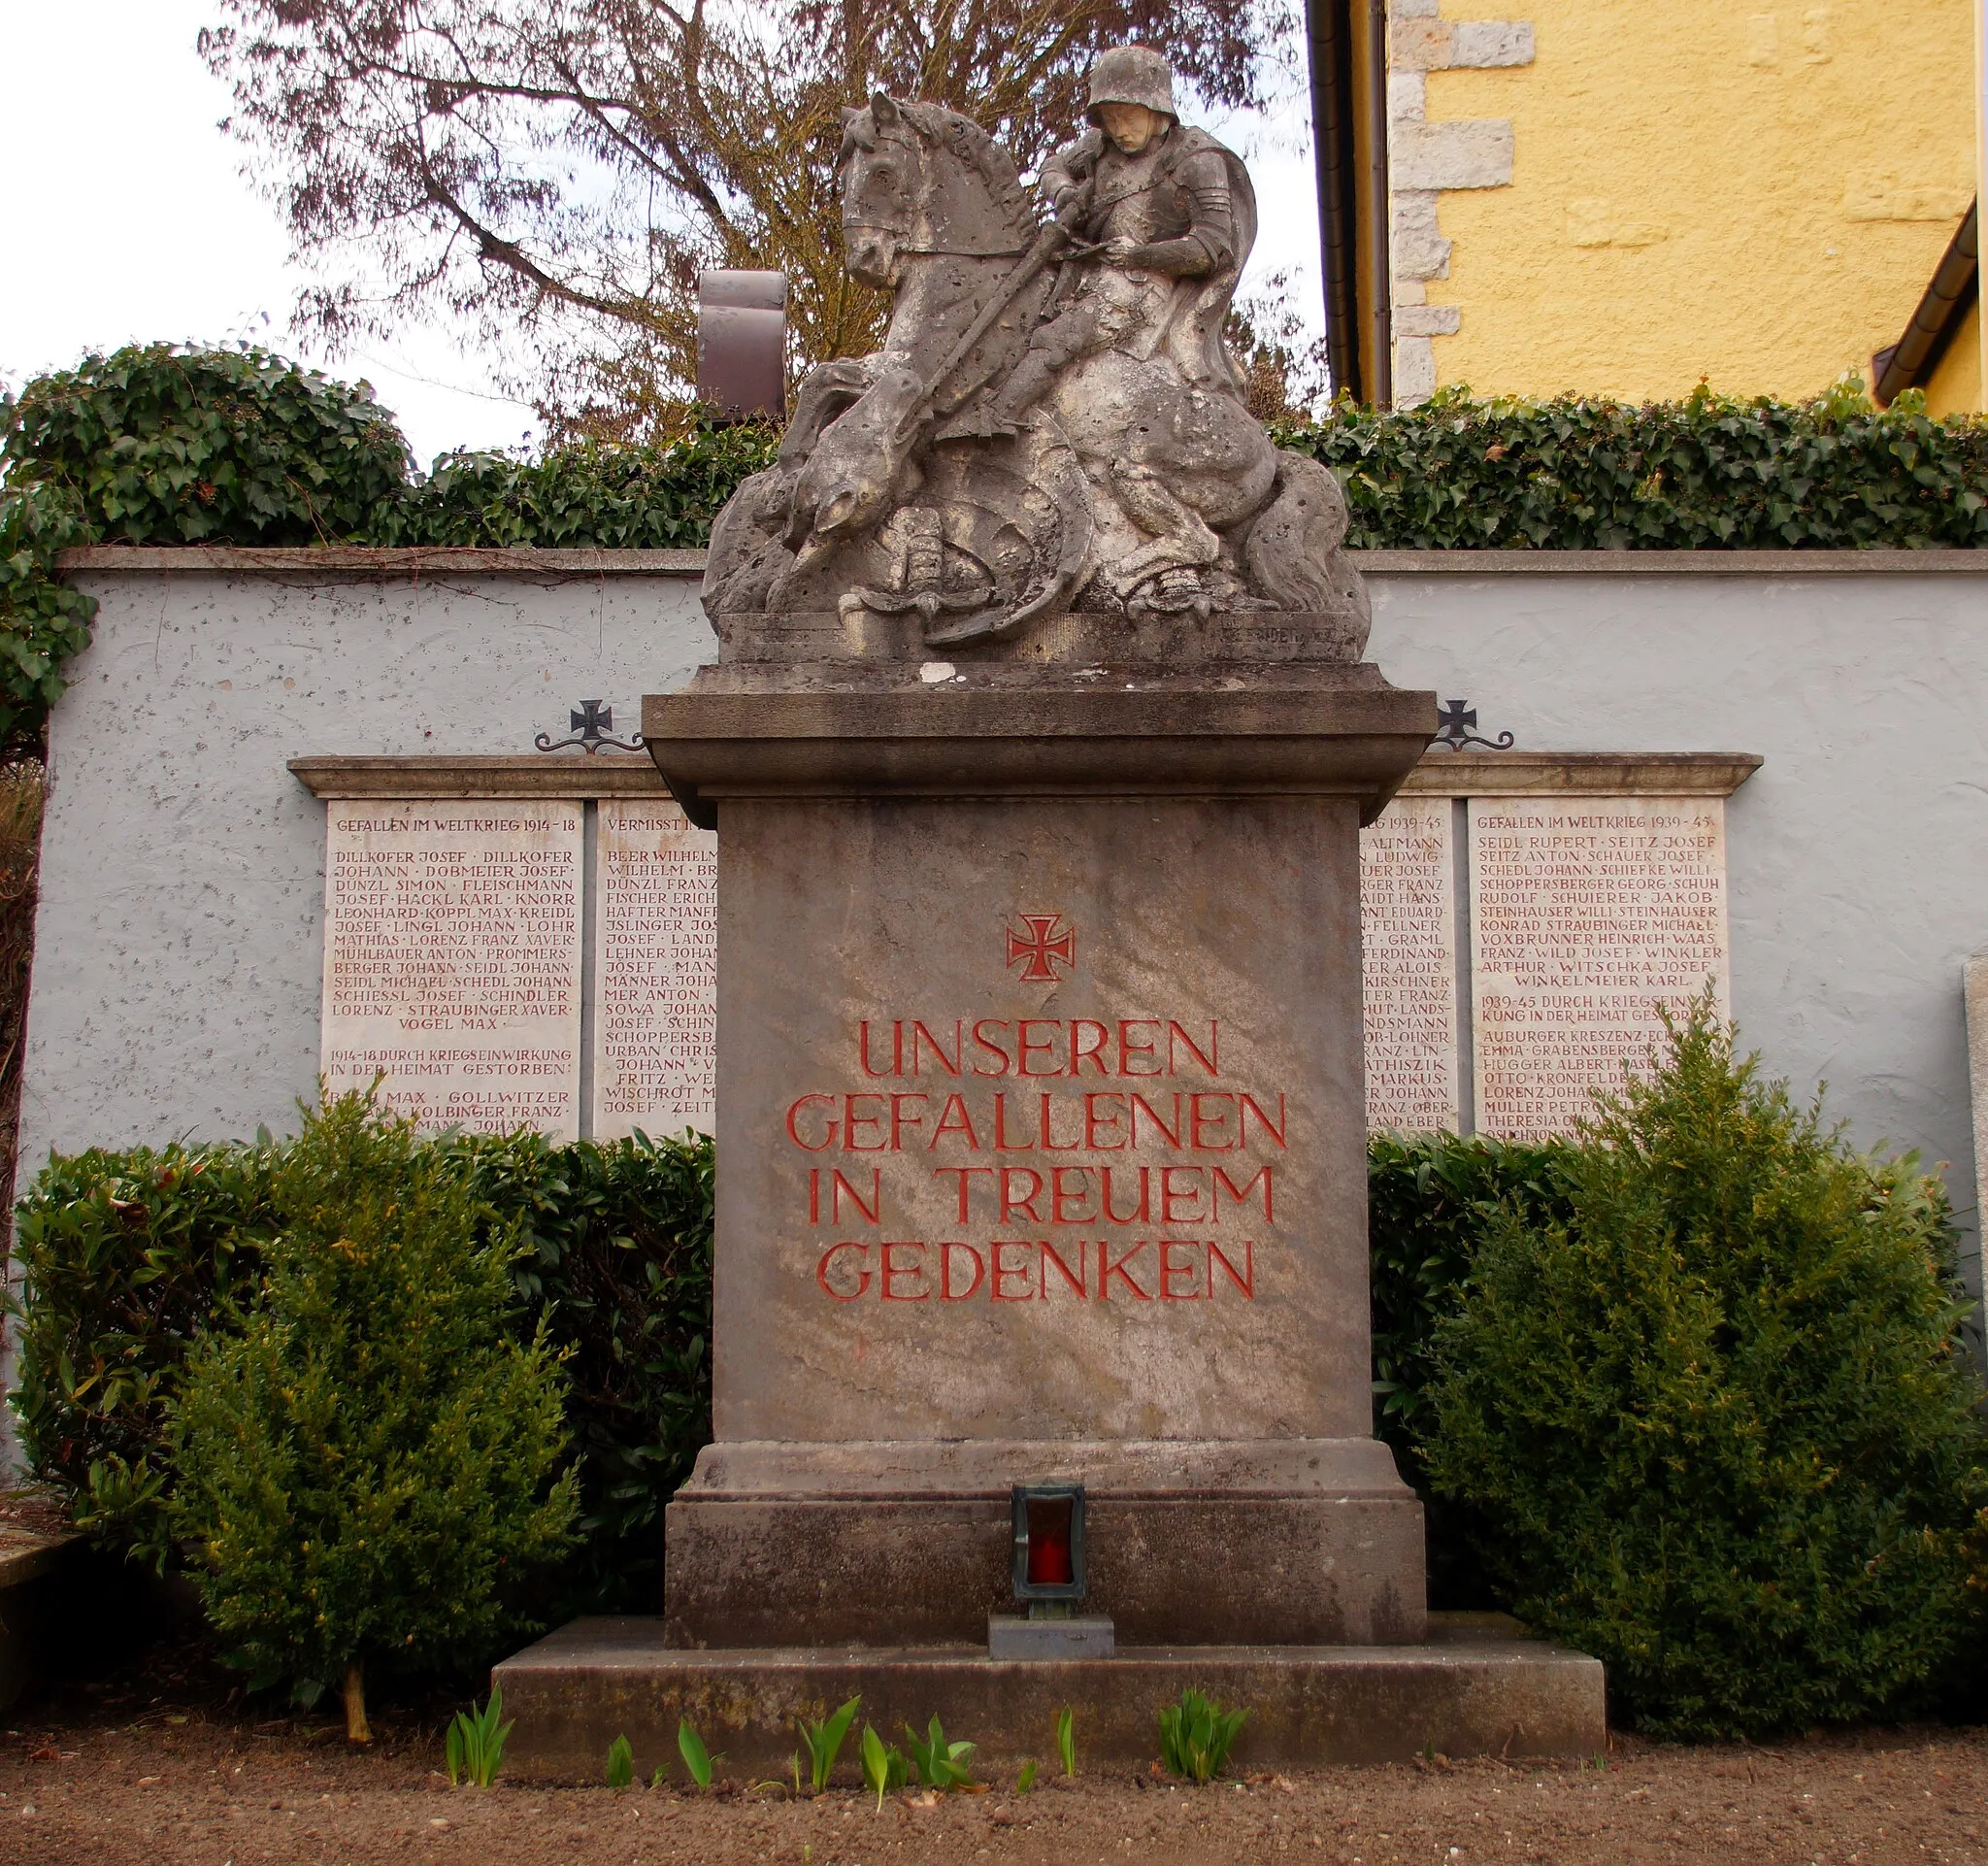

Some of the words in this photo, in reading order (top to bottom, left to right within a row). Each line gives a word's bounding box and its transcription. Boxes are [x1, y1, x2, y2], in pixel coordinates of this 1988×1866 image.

[338, 819, 409, 832] GEFALLEN
[414, 819, 430, 832] IM
[434, 819, 519, 832] WELTKRIEG
[608, 819, 681, 831] VERMISST
[1477, 816, 1543, 829] GEFALLEN
[1549, 816, 1563, 829] IM
[1568, 816, 1645, 829] WELTKRIEG
[1368, 838, 1443, 849] ALTMANN
[1478, 837, 1523, 849] SEIDL
[1530, 837, 1597, 849] RUPERT
[1608, 837, 1658, 849] SEITZ
[1664, 837, 1715, 849] JOSEF
[336, 851, 414, 864] DILLKOFER
[419, 851, 466, 864] JOSEF
[483, 851, 573, 864] DILLKOFER
[608, 851, 649, 862] BEER
[1375, 851, 1438, 862] LUDWIG
[1479, 850, 1519, 862] SEITZ
[1525, 850, 1579, 862] ANTON
[1588, 850, 1651, 862] SCHAUER
[1657, 850, 1706, 862] JOSEF
[334, 866, 409, 878] JOHANN
[426, 866, 514, 878] DOBMEIER
[520, 866, 569, 878] JOSEF
[609, 865, 683, 876] WILHELM
[1396, 866, 1440, 877] JOSEF
[1480, 865, 1534, 876] SCHEDL
[1534, 865, 1592, 876] JOHANN
[1670, 865, 1708, 876] WILLI
[336, 877, 388, 891] DÜNZL
[396, 880, 447, 891] SIMON
[463, 880, 573, 891] FLEISCHMANN
[607, 877, 661, 889] DÜNZL
[667, 879, 717, 889] FRANZ
[1398, 880, 1443, 891] FRANZ
[1480, 879, 1614, 890] SCHOPPERSBERGER
[1618, 879, 1666, 890] GEORG
[1673, 879, 1719, 890] SCHUH
[336, 894, 388, 905] JOSEF
[460, 894, 503, 905] KARL
[515, 894, 576, 905] KNORR
[607, 893, 668, 904] FISCHER
[673, 893, 714, 904] ERICH
[1399, 893, 1440, 904] HANS
[1479, 892, 1537, 904] RUDOLF
[1551, 892, 1640, 904] SCHUIERER
[1651, 892, 1712, 904] JAKOB
[335, 908, 418, 918] LEONHARD
[480, 908, 513, 918] MAX
[519, 908, 575, 918] KREIDL
[607, 907, 666, 917] HAFTER
[1392, 907, 1443, 917] EDUARD
[1480, 907, 1573, 918] STEINHAUSER
[1577, 907, 1612, 918] WILLI
[1616, 907, 1718, 918] STEINHAUSER
[335, 921, 381, 933] JOSEF
[393, 921, 443, 933] LINGL
[447, 921, 515, 933] JOHANN
[1374, 920, 1441, 931] FELLNER
[1480, 920, 1541, 932] KONRAD
[1546, 920, 1647, 932] STRAUBINGER
[1652, 920, 1714, 932] MICHAEL
[334, 935, 399, 946] MATHIAS
[411, 935, 467, 946] LORENZ
[472, 935, 519, 946] FRANZ
[527, 935, 572, 946] XAVER
[607, 934, 655, 945] JOSEF
[1388, 935, 1443, 945] GRAML
[1481, 934, 1594, 946] VOXBRUNNER
[1599, 934, 1665, 946] HEINRICH
[1673, 934, 1714, 946] WAAS
[334, 946, 424, 960] MÜHLBAUER
[427, 949, 477, 960] ANTON
[606, 949, 666, 958] LEHNER
[1480, 948, 1525, 959] FRANZ
[1536, 948, 1575, 959] WILD
[1581, 948, 1638, 959] JOSEF
[1644, 948, 1723, 959] WINKLER
[335, 962, 390, 974] BERGER
[396, 962, 456, 974] JOHANN
[465, 962, 506, 974] SEIDL
[510, 962, 571, 974] JOHANN
[606, 962, 656, 973] JOSEF
[1394, 962, 1441, 974] ALOIS
[1481, 961, 1545, 973] ARTHUR
[1559, 961, 1652, 973] WITSCHKA
[1657, 961, 1711, 973] JOSEF
[335, 976, 376, 988] SEIDL
[381, 976, 447, 988] MICHAEL
[454, 976, 510, 988] SCHEDL
[514, 976, 572, 988] JOHANN
[1366, 977, 1449, 987] KIRSCHNER
[1514, 975, 1646, 988] WINKELMEIER
[1646, 975, 1690, 988] KARL
[334, 990, 410, 1002] SCHIESSL
[415, 990, 466, 1002] JOSEF
[480, 990, 569, 1002] SCHINDLER
[604, 990, 639, 1001] MER
[646, 990, 700, 1001] ANTON
[1400, 990, 1448, 1001] FRANZ
[1541, 996, 1593, 1009] DURCH
[333, 1005, 392, 1016] LORENZ
[408, 1005, 518, 1016] STRAUBINGER
[521, 1005, 569, 1016] XAVER
[605, 1004, 654, 1015] SOWA
[606, 1017, 654, 1028] JOSEF
[1482, 1011, 1525, 1023] KUNG
[1530, 1011, 1542, 1023] IN
[1547, 1011, 1573, 1023] DER
[1577, 1011, 1629, 1023] HEIMAT
[399, 1018, 453, 1030] VOGEL
[461, 1018, 497, 1030] MAX
[1390, 1032, 1449, 1043] LOHNER
[1484, 1031, 1566, 1043] AUBURGER
[1571, 1031, 1642, 1043] KRESZENZ
[606, 1046, 660, 1056] URBAN
[858, 1018, 1219, 1079] UNSEREN
[1482, 1046, 1524, 1056] EMMA
[380, 1050, 424, 1061] DURCH
[429, 1050, 572, 1061] KRIEGSEINWIRKUNG
[330, 1064, 345, 1076] IN
[391, 1064, 454, 1076] HEIMAT
[616, 1059, 685, 1070] JOHANN
[1483, 1059, 1552, 1070] HUGGER
[1557, 1059, 1613, 1070] ALBERT
[617, 1074, 666, 1084] FRITZ
[1372, 1074, 1441, 1085] MARKUS
[1484, 1073, 1527, 1084] OTTO
[388, 1091, 426, 1103] MAX
[448, 1091, 569, 1103] GOLLWITZER
[1385, 1087, 1447, 1099] JOHANN
[1484, 1087, 1544, 1100] LORENZ
[512, 1107, 563, 1118] FRANZ
[604, 1101, 656, 1113] JOSEF
[785, 1092, 1288, 1152] GEFALLENEN
[1486, 1116, 1558, 1128] THERESIA
[808, 1165, 881, 1226] IN
[932, 1165, 1276, 1226] TREUEM
[815, 1240, 1255, 1303] GEDENKEN
